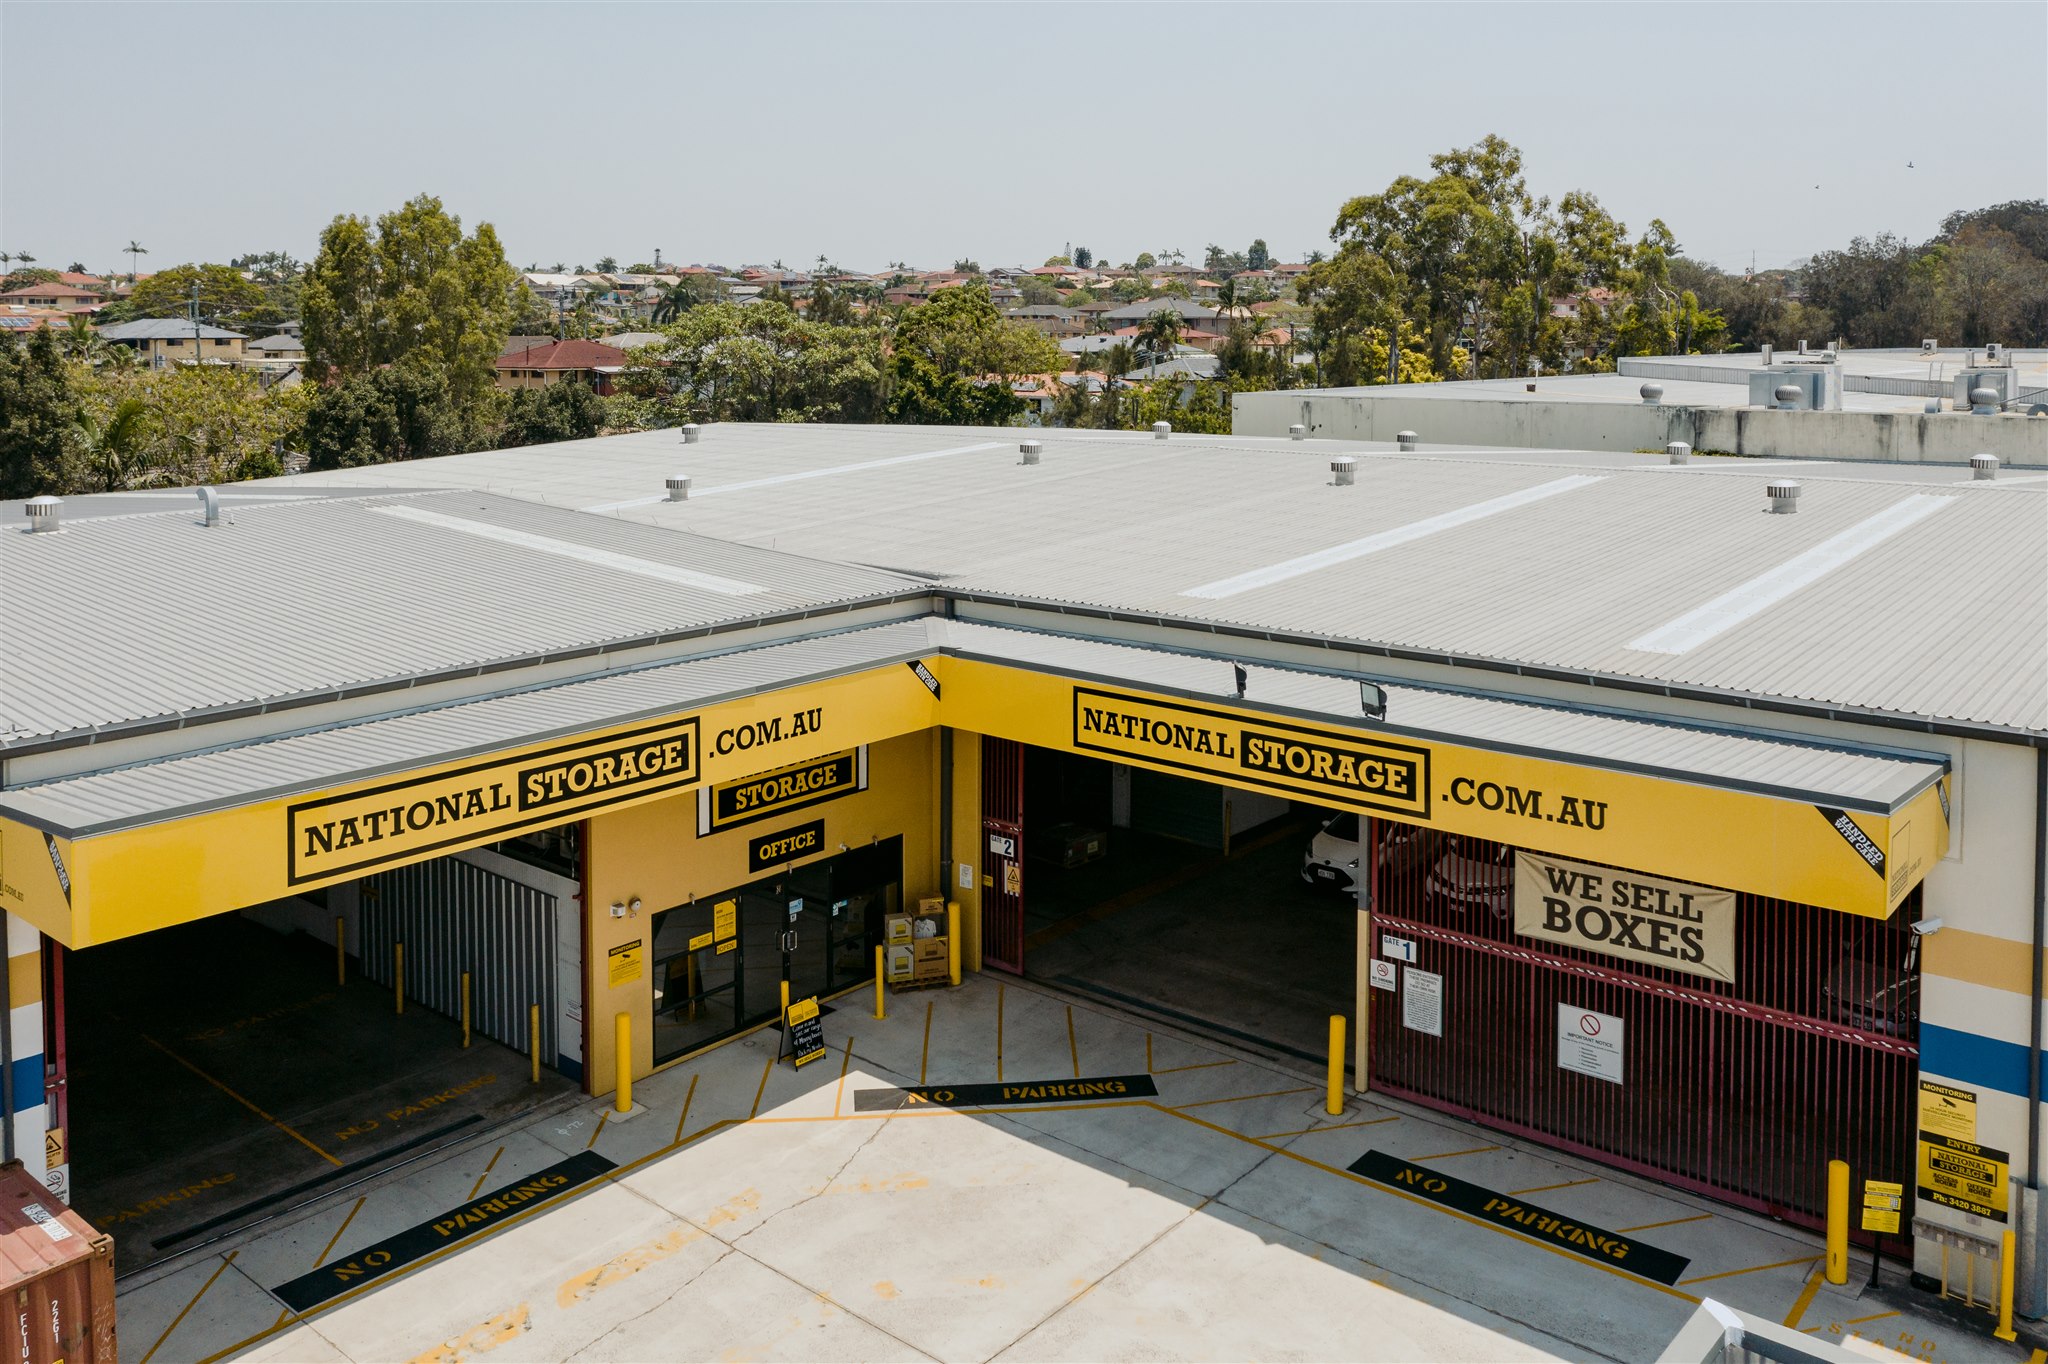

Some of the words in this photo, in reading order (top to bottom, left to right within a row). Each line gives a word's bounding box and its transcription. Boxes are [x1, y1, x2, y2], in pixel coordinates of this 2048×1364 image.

[1083, 707, 1235, 760] NATIONAL
[1248, 738, 1408, 795] STORAGE
[1442, 777, 1608, 831] .COM.AU
[305, 783, 512, 858] NATIONAL
[527, 740, 683, 804] STORAGE
[709, 708, 823, 759] .COM.AU
[735, 763, 837, 811] STORAGE
[759, 830, 816, 861] OFFICE
[1004, 840, 1012, 855] 2
[1834, 819, 1858, 844] WITH
[1855, 842, 1879, 867] CARE
[1838, 815, 1884, 862] HANDLED
[1544, 866, 1602, 902] WE
[1611, 880, 1704, 924] SELL
[1383, 936, 1400, 947] GATE
[1542, 896, 1705, 964] BOXES
[1402, 941, 1411, 960] 1
[1567, 1032, 1594, 1043] IMPORTANT
[1595, 1039, 1614, 1048] NOTICE
[386, 1072, 497, 1121] PARKING
[907, 1090, 955, 1104] NO
[1003, 1081, 1128, 1101] PARKING
[1923, 1083, 1973, 1101] MONITORING
[1946, 1138, 1981, 1154] ENTRY
[1937, 1151, 1989, 1172] NATIONAL
[1939, 1161, 1988, 1180] STORAGE
[1933, 1172, 1959, 1185] ACCESS
[1966, 1181, 1993, 1194] OFFICE
[1932, 1192, 1948, 1202] Ph:
[1949, 1196, 1970, 1210] 3420
[1394, 1168, 1448, 1193] NO
[1483, 1197, 1630, 1259] PARKING
[331, 1249, 392, 1284] NO
[432, 1173, 569, 1238] PARKING
[51, 1300, 60, 1344] 22G1
[1899, 1331, 1936, 1352] NO
